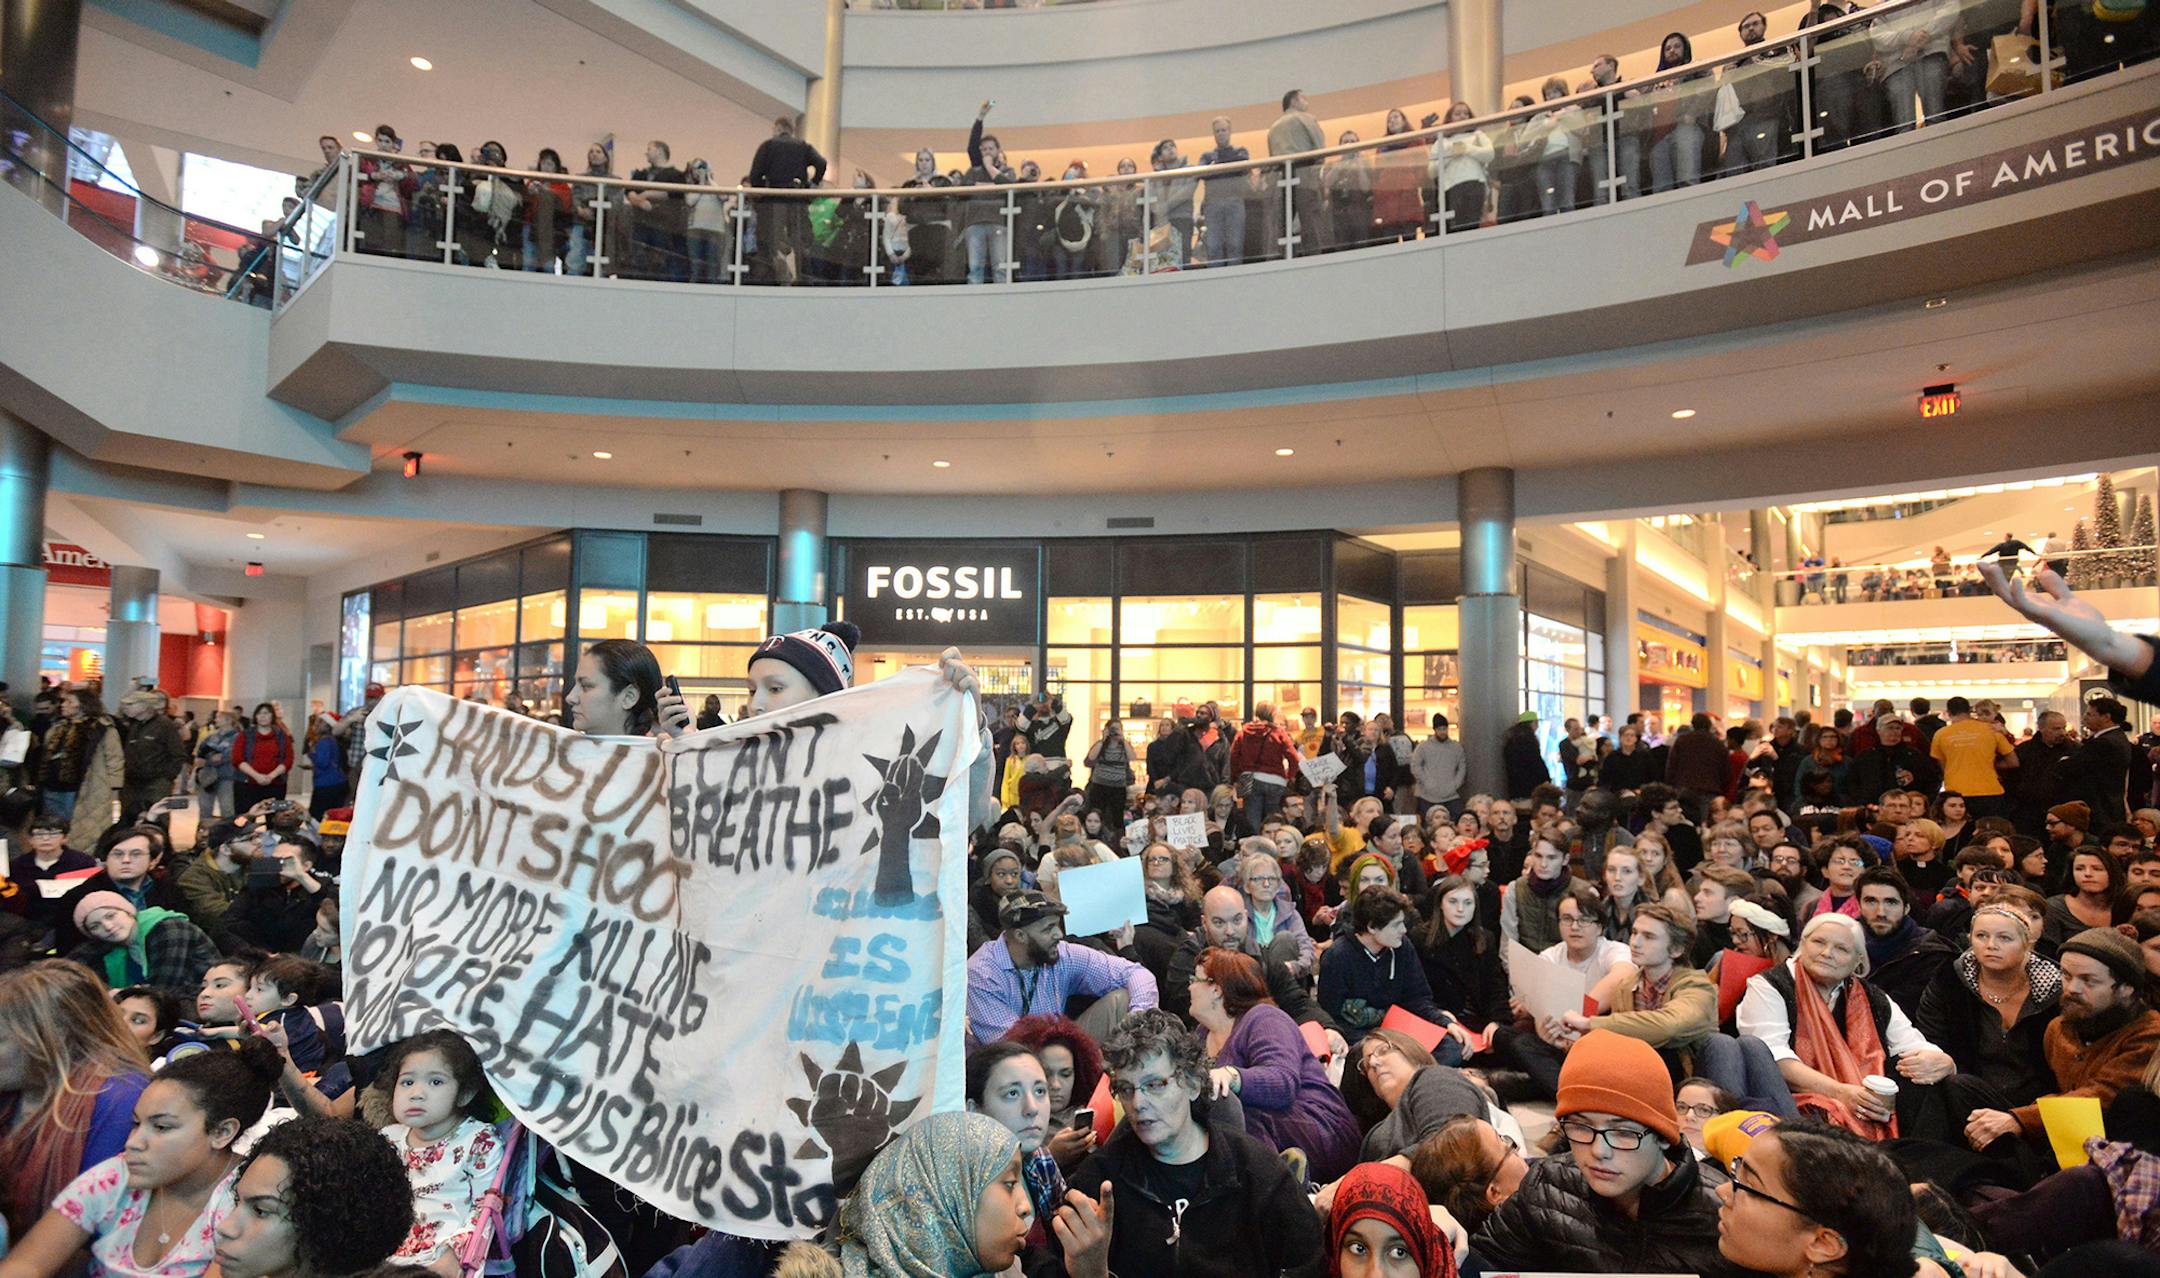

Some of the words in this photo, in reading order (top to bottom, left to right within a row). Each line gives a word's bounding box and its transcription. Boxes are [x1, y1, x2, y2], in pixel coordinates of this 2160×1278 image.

[1807, 190, 1903, 231] MALL
[1919, 170, 1975, 204] OF
[1922, 397, 1956, 418] EXIT
[867, 566, 1023, 600] FOSSIL
[895, 608, 930, 621] EST.
[957, 608, 989, 621] USA
[424, 699, 601, 801] HANDS
[668, 777, 853, 875] BREATHE
[359, 856, 440, 927] NO
[429, 872, 568, 964] MORE
[821, 933, 911, 984] IS
[506, 975, 675, 1099] HATE
